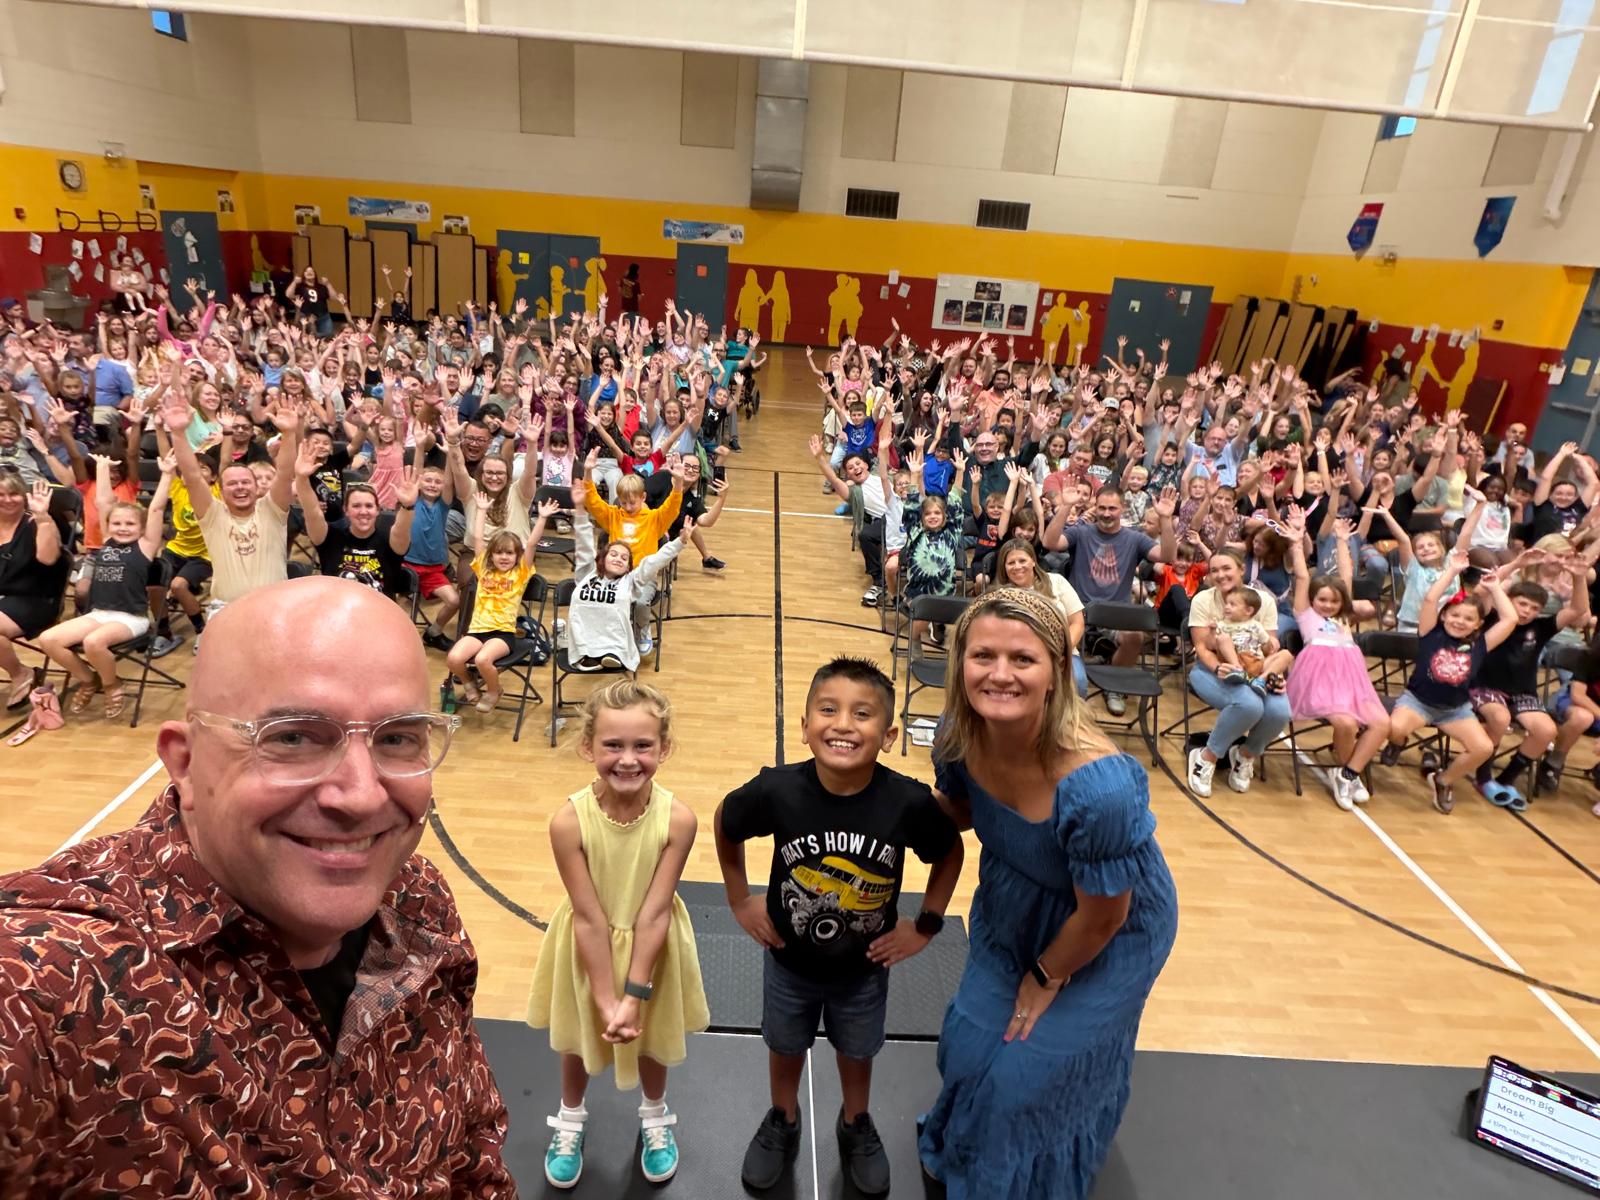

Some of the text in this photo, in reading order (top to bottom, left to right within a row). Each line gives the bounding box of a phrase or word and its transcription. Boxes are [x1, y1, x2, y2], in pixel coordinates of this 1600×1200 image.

[308, 289, 318, 303] 9
[579, 589, 616, 604] CLUB
[824, 831, 866, 855] HOW
[867, 838, 878, 859] I
[1501, 1085, 1536, 1105] Dream
[1538, 1101, 1555, 1115] Big
[1497, 1102, 1526, 1120] Mask
